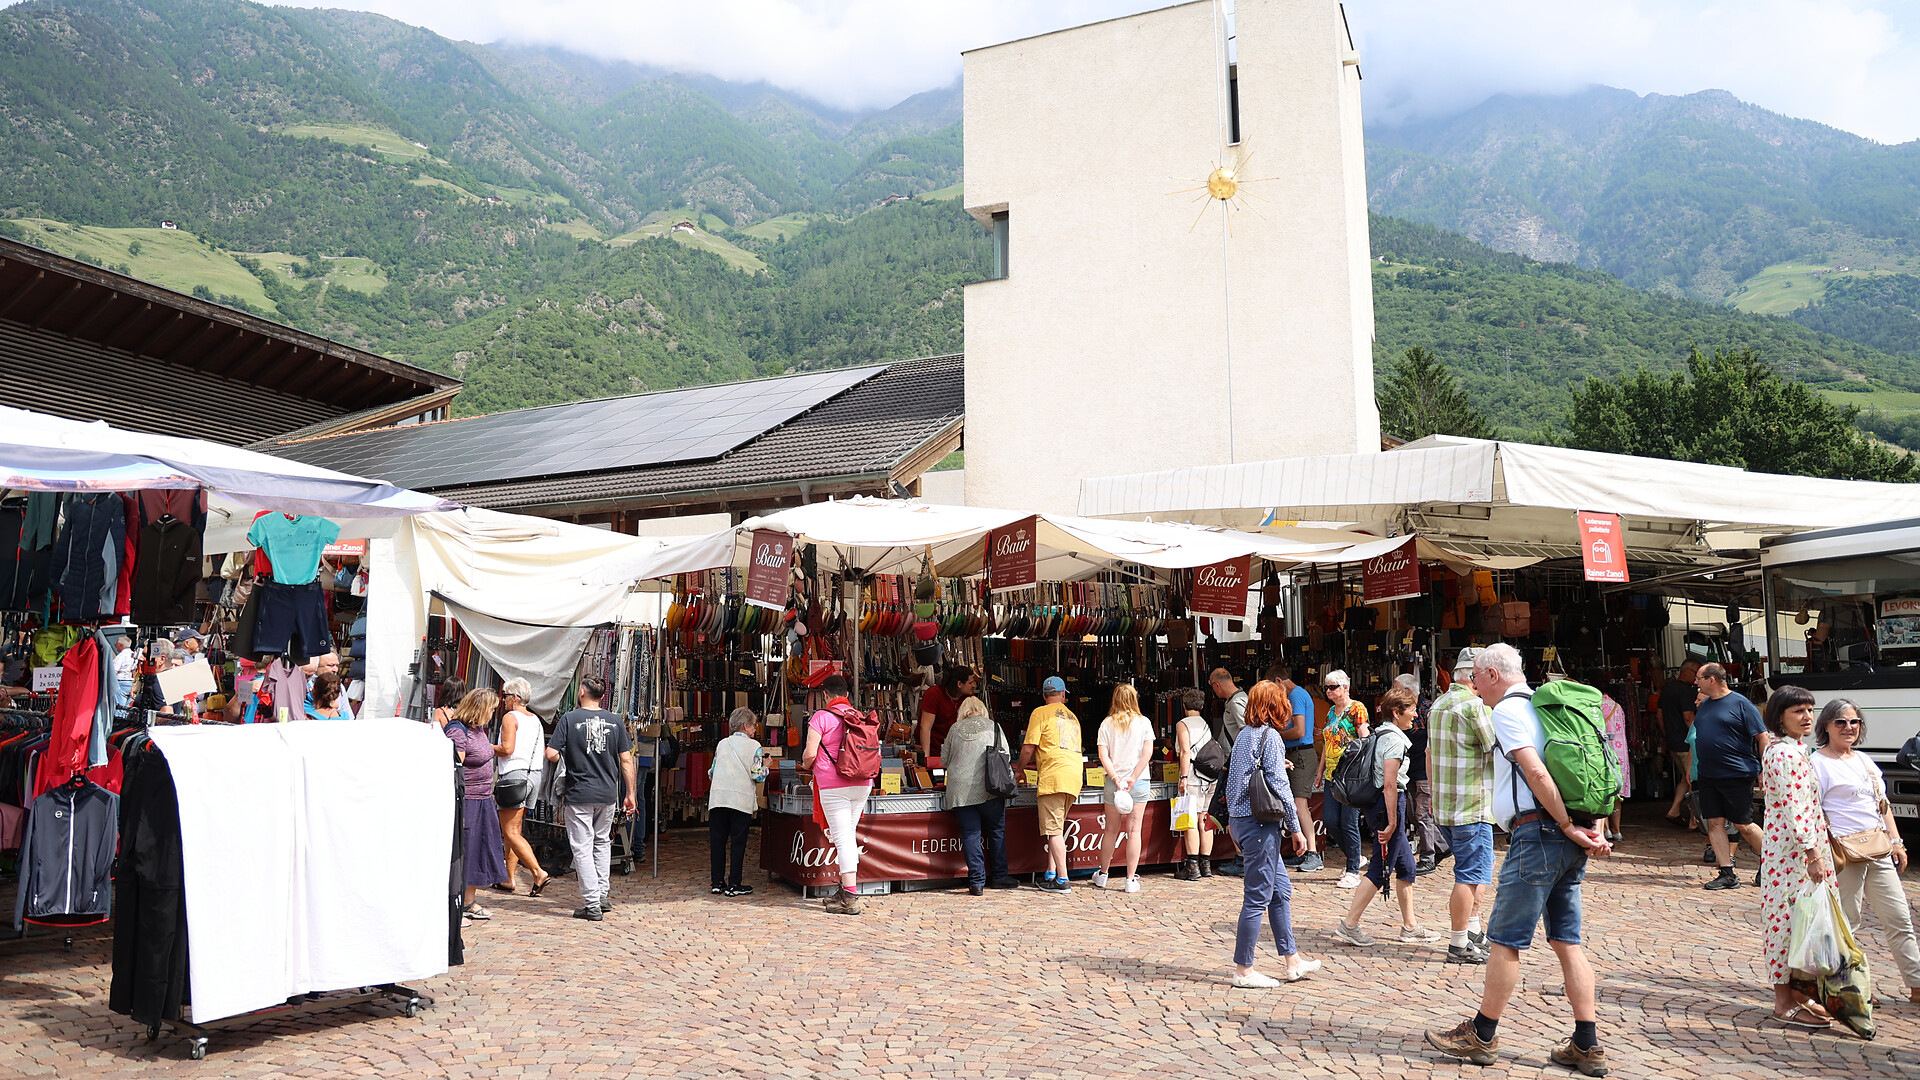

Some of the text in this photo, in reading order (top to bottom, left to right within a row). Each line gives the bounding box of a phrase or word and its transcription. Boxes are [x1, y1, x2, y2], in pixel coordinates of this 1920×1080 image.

[342, 544, 363, 552] Zanol
[995, 534, 1031, 557] Baur
[755, 543, 786, 569] Baur
[1367, 556, 1411, 576] Baur
[1197, 566, 1242, 588] Baur
[1586, 568, 1625, 578] Rainer Zanol
[1906, 807, 1917, 816] VK
